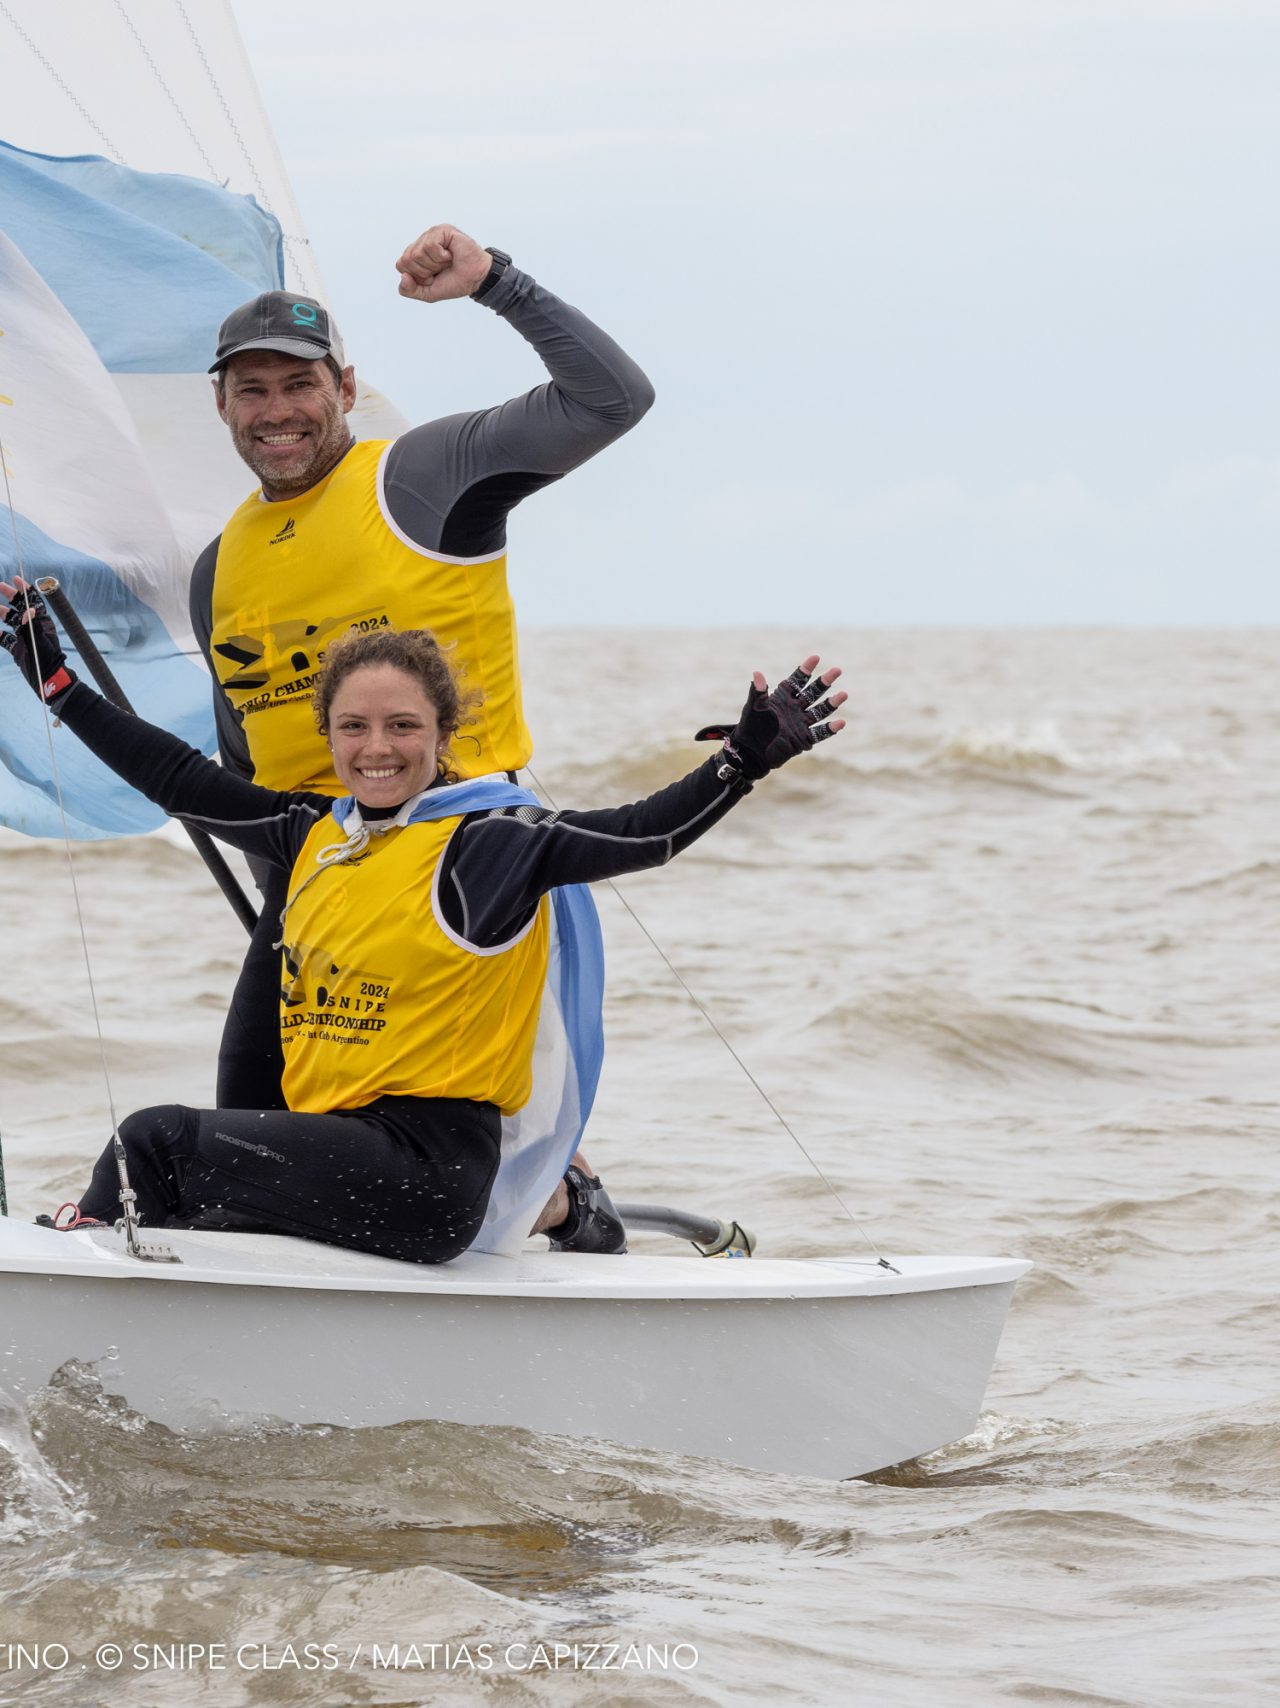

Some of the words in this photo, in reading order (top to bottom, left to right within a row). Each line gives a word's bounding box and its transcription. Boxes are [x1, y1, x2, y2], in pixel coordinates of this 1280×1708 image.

[360, 982, 391, 999] 2024
[327, 996, 387, 1012] SNIPE
[331, 1033, 370, 1046] Argentino
